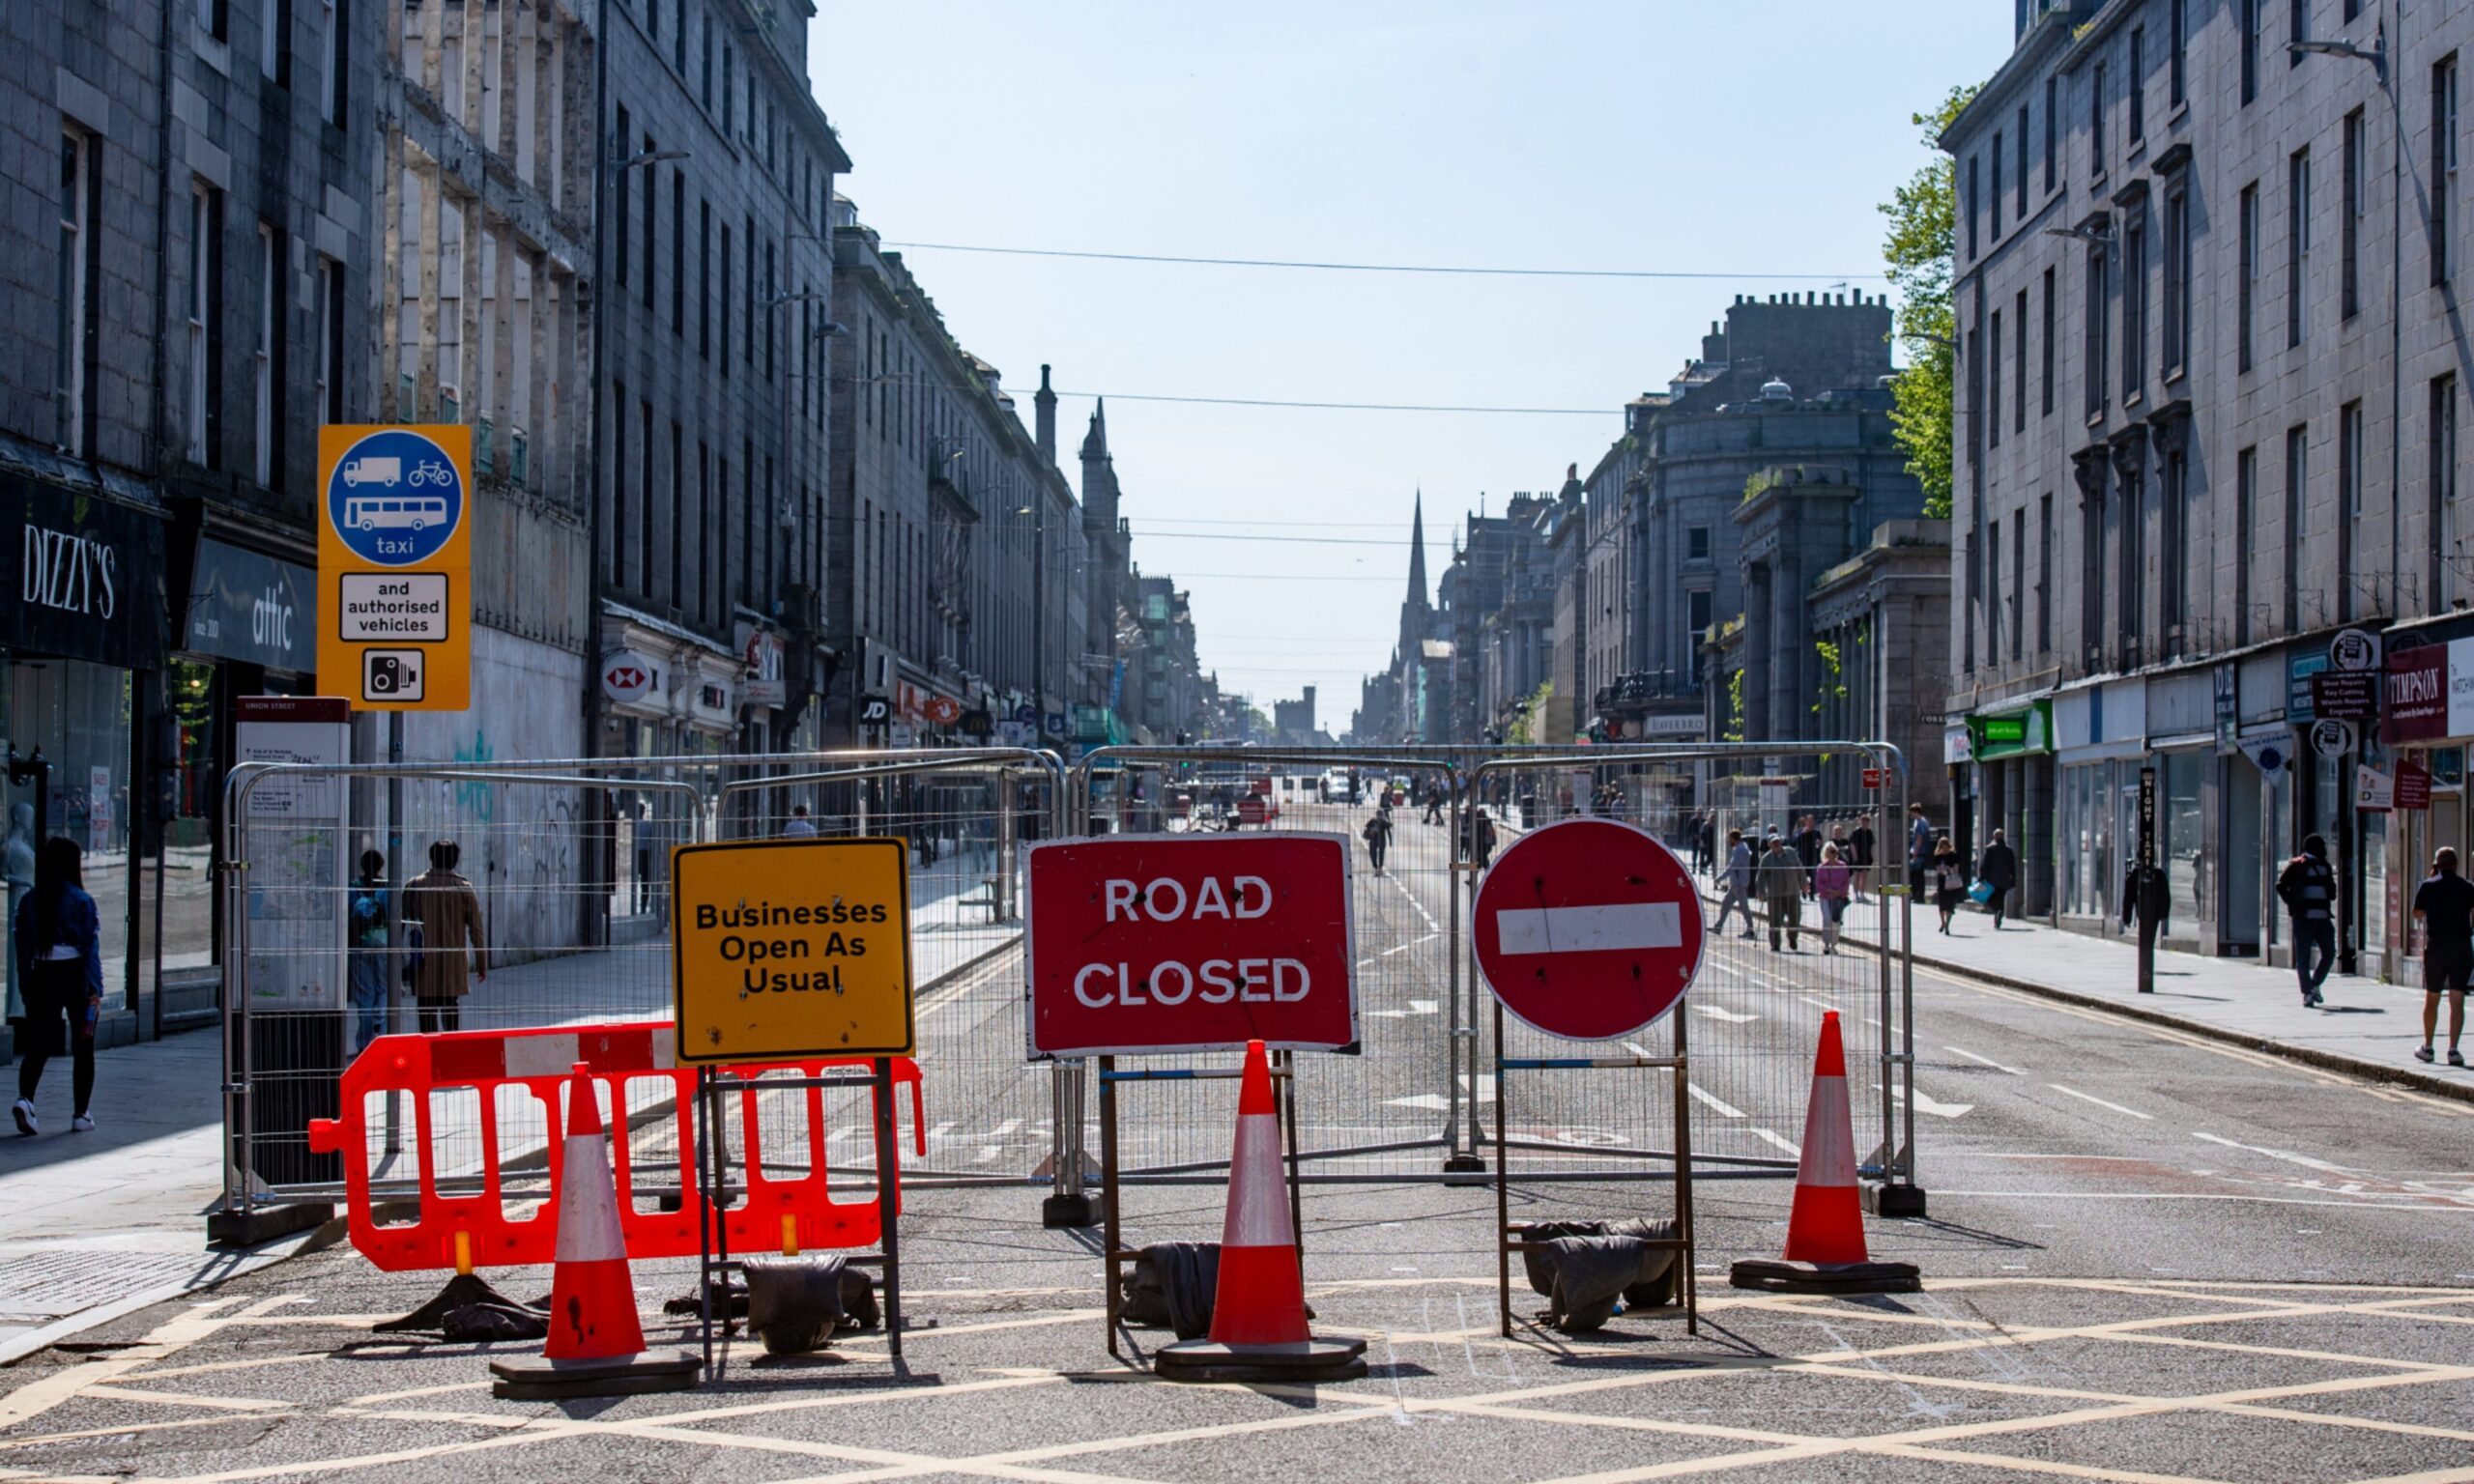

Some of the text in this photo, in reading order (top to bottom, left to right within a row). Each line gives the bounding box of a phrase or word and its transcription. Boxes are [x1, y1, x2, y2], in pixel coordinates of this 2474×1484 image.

[376, 537, 414, 554] taxi
[23, 524, 115, 619] DIZZY'S
[378, 582, 410, 595] and
[252, 581, 292, 650] attic
[348, 600, 440, 614] authorised
[359, 618, 429, 632] vehicles
[2390, 668, 2439, 704] TIMPSON
[862, 701, 886, 719] JD
[2143, 780, 2152, 822] NIGHT
[1105, 875, 1273, 922] ROAD
[697, 901, 887, 929] Businesses
[720, 931, 866, 964] Open As
[744, 964, 841, 993] Usual
[1074, 957, 1311, 1008] CLOSED
